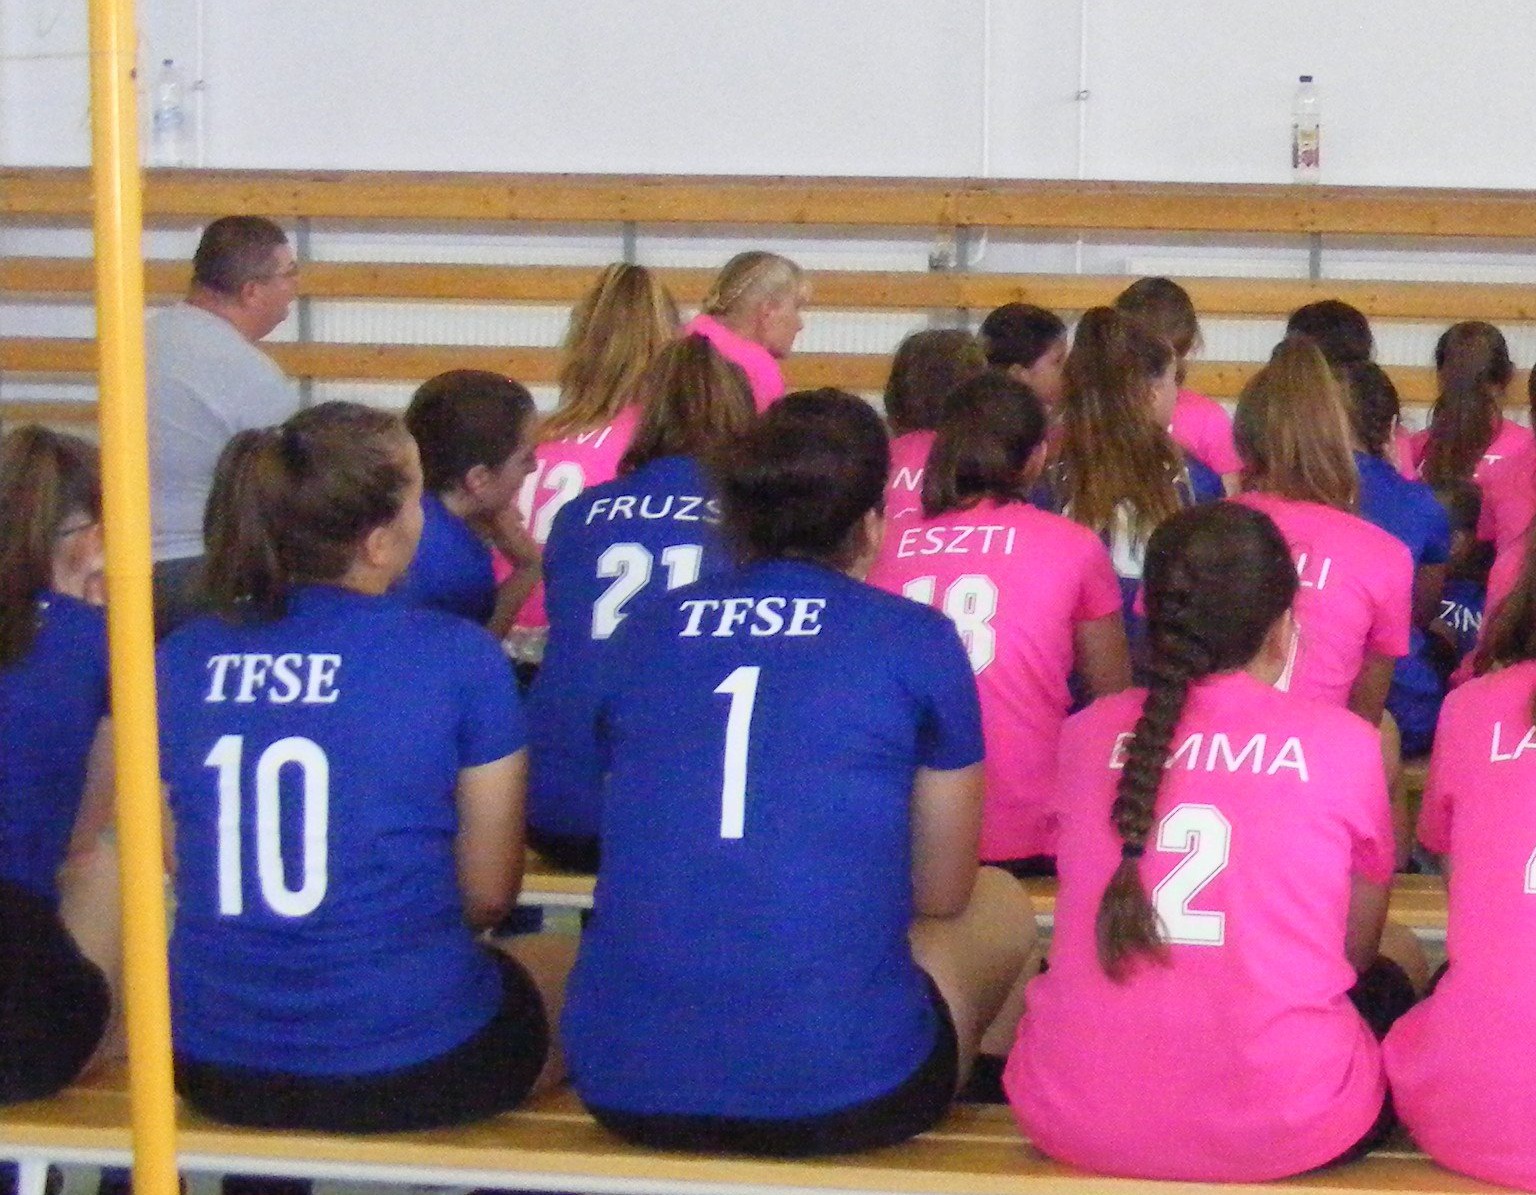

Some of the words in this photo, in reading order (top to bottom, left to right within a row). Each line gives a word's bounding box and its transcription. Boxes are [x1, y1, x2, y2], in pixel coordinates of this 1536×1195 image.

[897, 525, 1016, 558] ESZTI
[678, 597, 826, 637] TFSE
[204, 653, 342, 703] TFSE
[713, 666, 761, 839] 1
[204, 734, 329, 917] 10
[1152, 803, 1232, 946] 2
